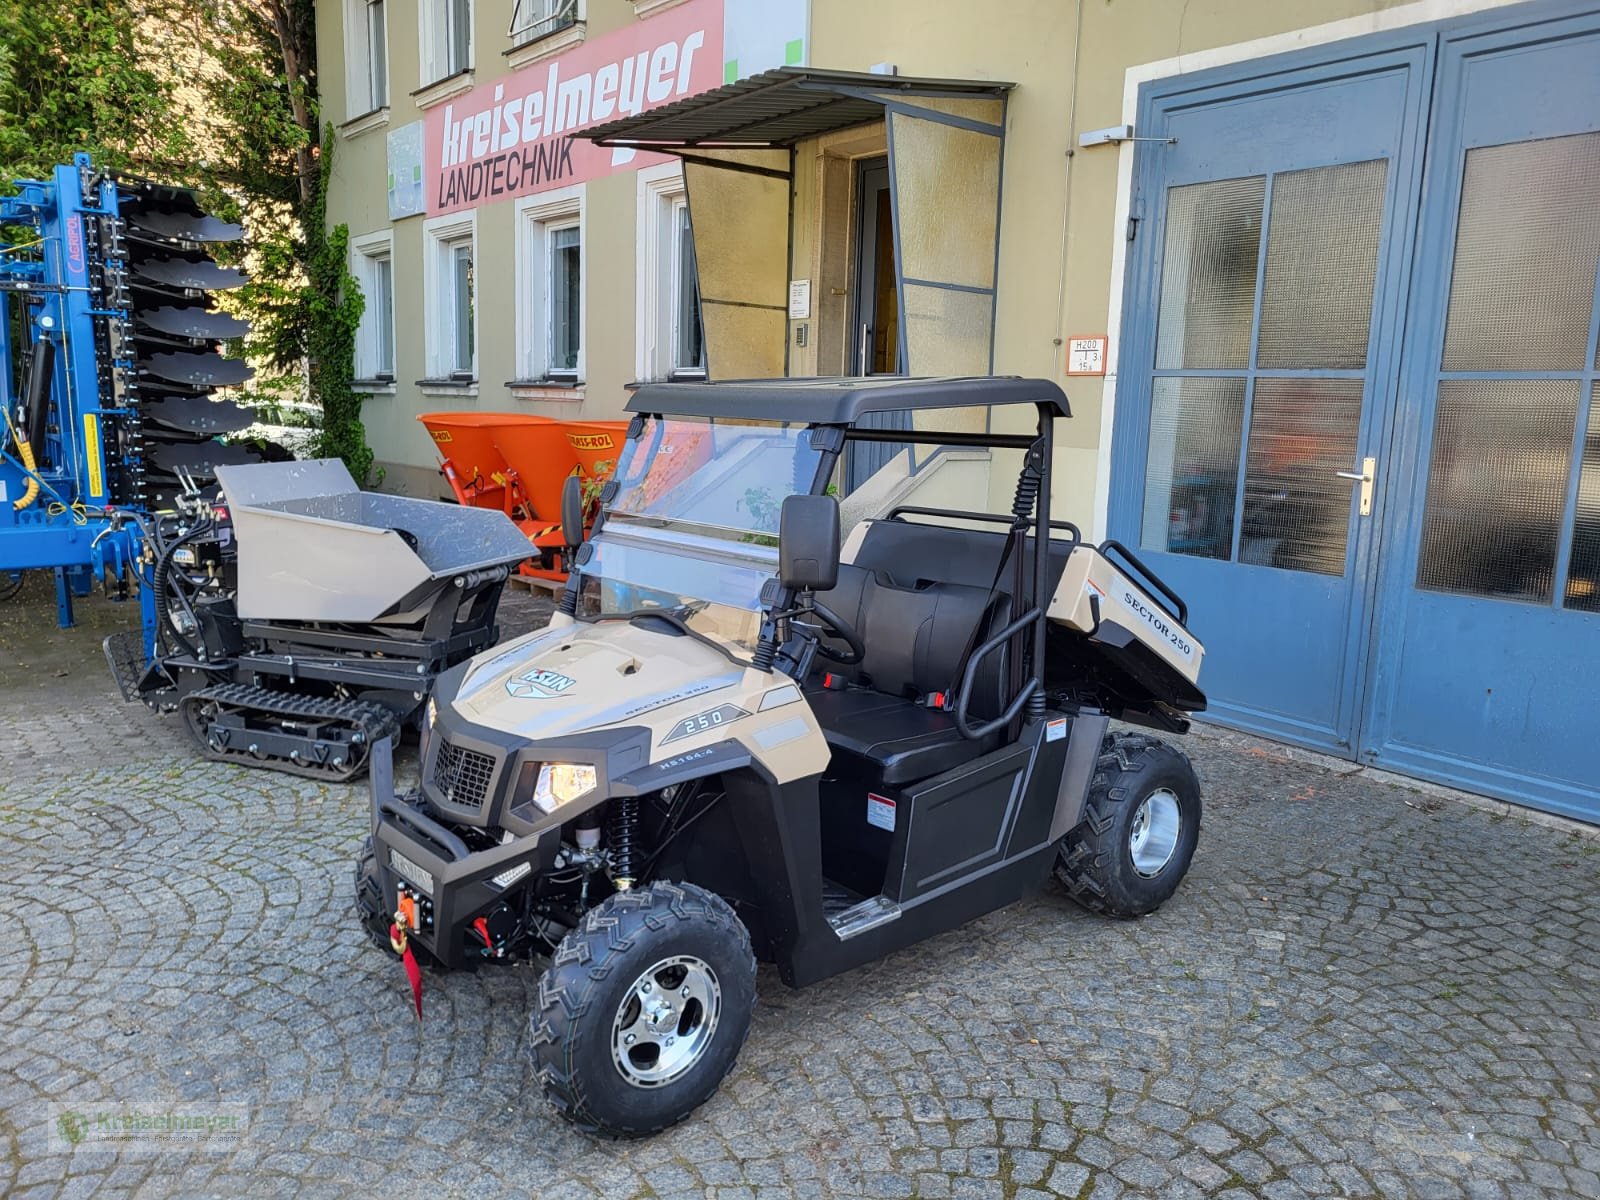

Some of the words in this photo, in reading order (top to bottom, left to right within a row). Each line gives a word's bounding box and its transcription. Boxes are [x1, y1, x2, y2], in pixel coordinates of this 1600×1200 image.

[441, 30, 705, 167] kreiselmeyer
[438, 137, 574, 209] LANDTECHNIK
[1124, 592, 1169, 638] SECTOR
[1170, 633, 1190, 655] 250
[684, 711, 722, 733] 250
